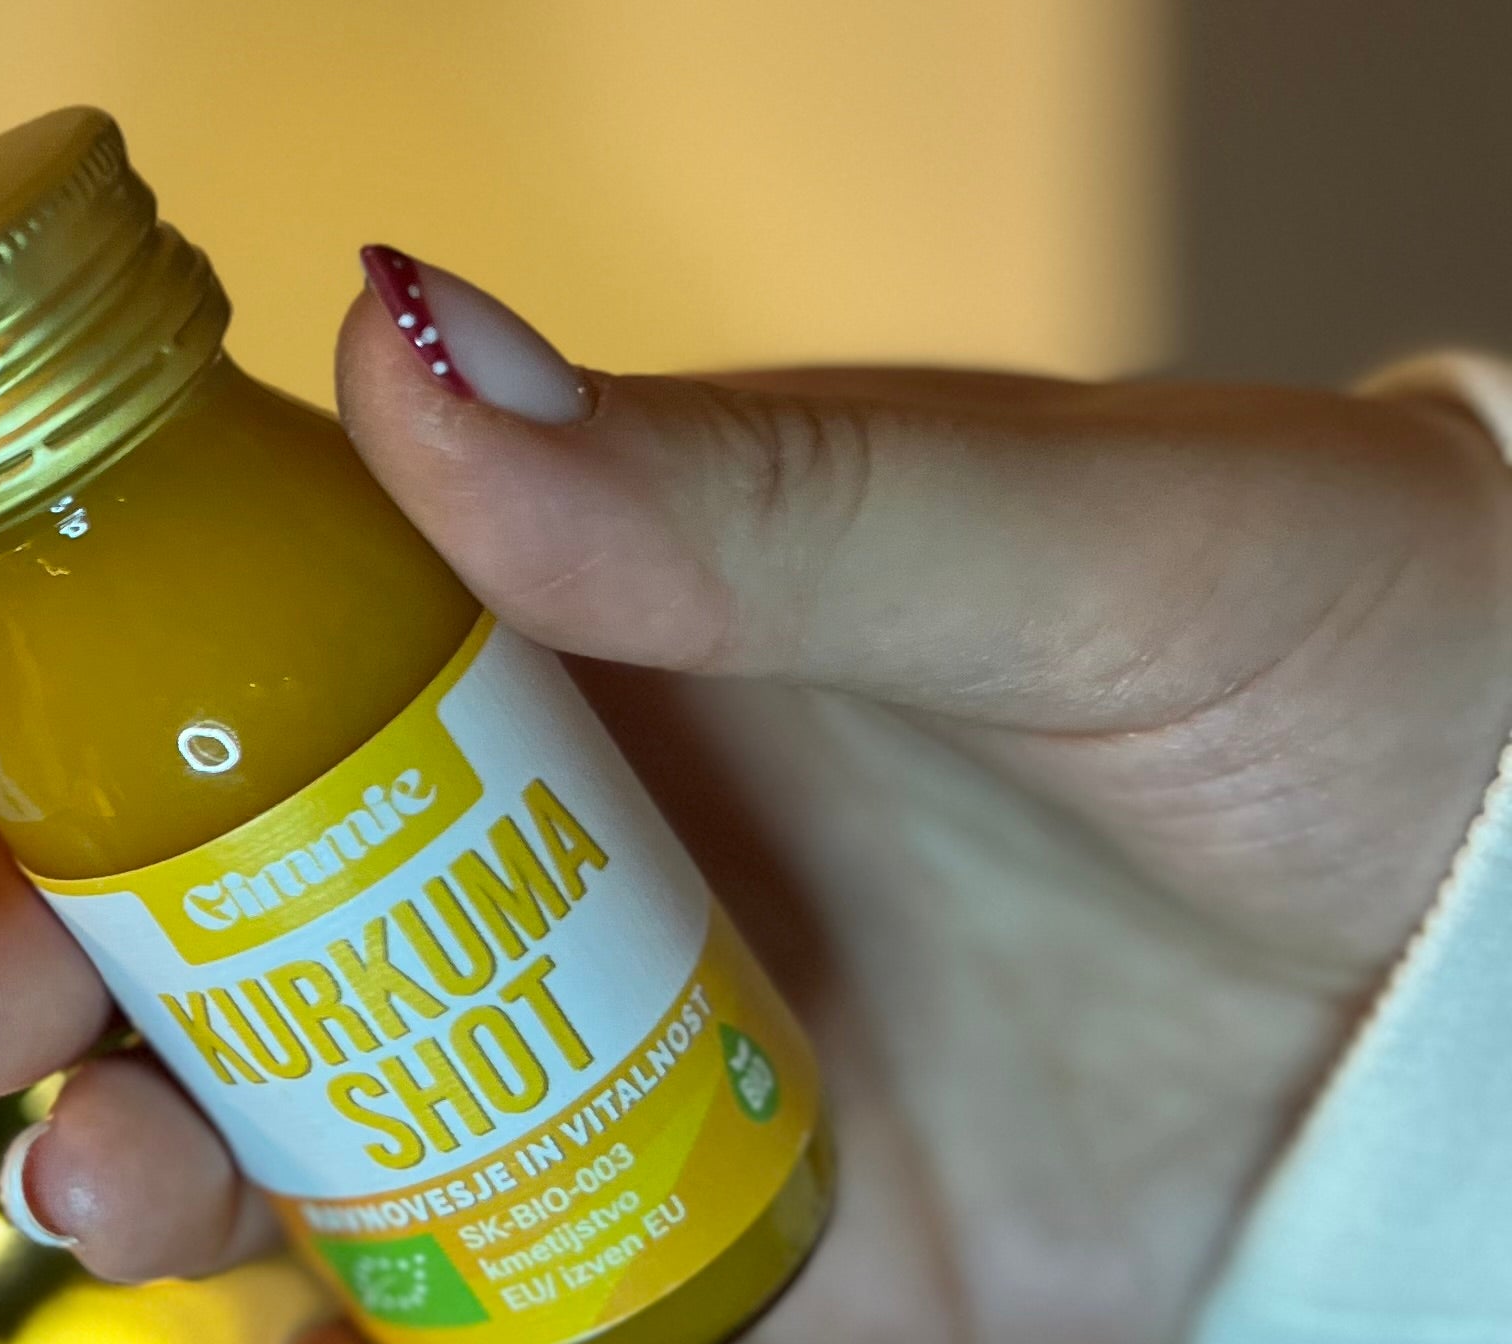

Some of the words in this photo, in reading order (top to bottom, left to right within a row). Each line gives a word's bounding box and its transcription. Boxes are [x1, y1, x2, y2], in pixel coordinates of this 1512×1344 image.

[183, 768, 437, 930] Gimmie
[158, 778, 609, 1086] KURKUMA
[326, 954, 594, 1170] SHOT
[515, 1136, 567, 1177] IN
[560, 984, 714, 1147] VITALNOST
[458, 1142, 635, 1250] SK-BIO-003
[478, 1190, 640, 1282] kmetijstvo
[500, 1272, 557, 1312] EU/
[564, 1232, 644, 1289] izven
[642, 1194, 686, 1240] EU
